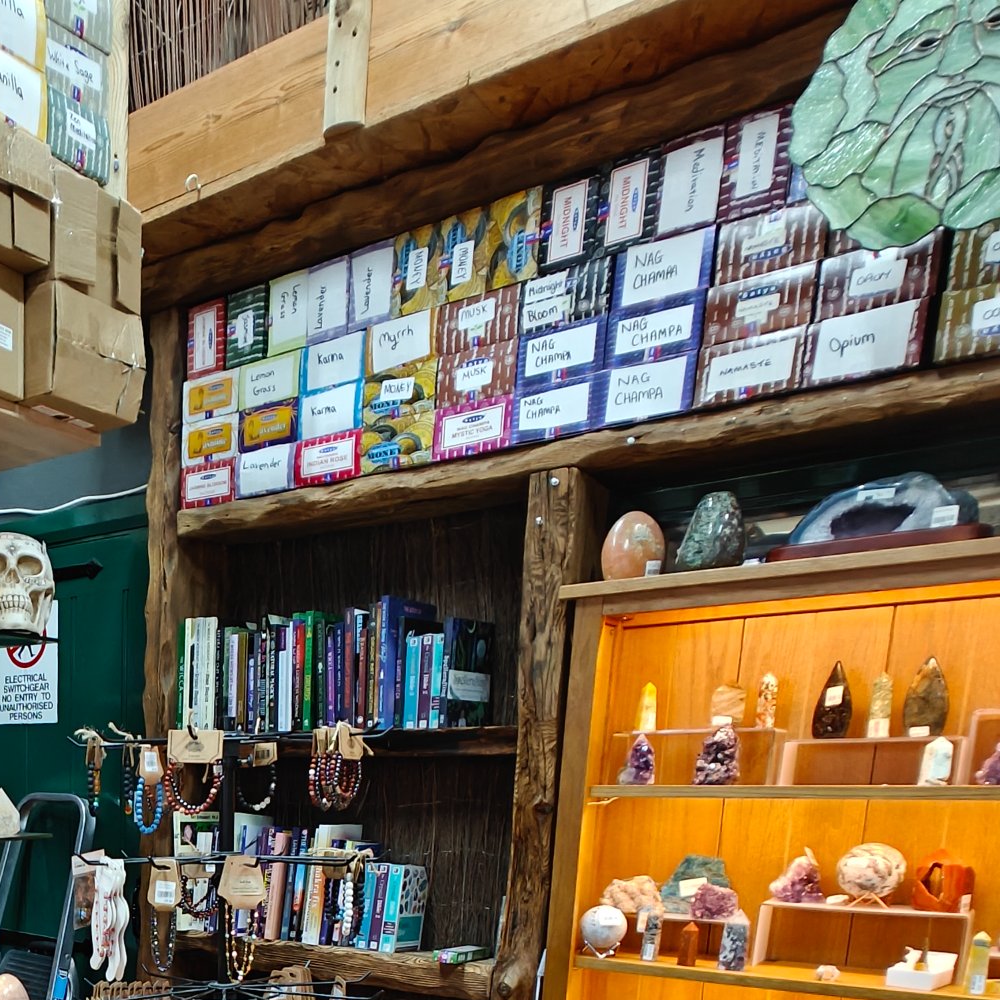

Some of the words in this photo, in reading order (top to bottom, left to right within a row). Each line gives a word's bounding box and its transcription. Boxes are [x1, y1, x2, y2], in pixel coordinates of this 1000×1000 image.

[74, 59, 94, 83] Sage
[684, 147, 706, 213] Meditation
[618, 175, 631, 230] MIDNIGHT
[559, 196, 572, 249] MIDNIGHT
[455, 246, 469, 280] MONEY
[634, 250, 664, 270] NAG
[410, 250, 424, 286] MONEY
[632, 264, 678, 289] CHAMPA
[528, 281, 564, 297] Midnight
[461, 304, 488, 321] MUSK
[621, 317, 649, 334] NAG
[378, 328, 414, 351] Myrrh
[631, 324, 683, 346] CHAMPA
[531, 338, 555, 353] NAG
[828, 331, 875, 357] Opium
[317, 352, 345, 365] Karma
[535, 351, 572, 368] CHAMPA
[462, 366, 487, 380] MUSK
[718, 358, 772, 376] NAMASTE
[250, 369, 275, 382] Lemon
[618, 372, 651, 387] NAG
[253, 384, 276, 396] Grass
[383, 382, 412, 395] MONEY
[614, 386, 664, 406] CHAMPA
[524, 397, 543, 407] NAG
[310, 405, 337, 416] Karma
[526, 405, 561, 420] CHAMPA
[451, 430, 474, 439] MYSTIC
[475, 425, 493, 435] YOGA
[242, 457, 283, 472] Lavender
[307, 457, 328, 467] INDIAN
[329, 454, 349, 464] ROSE
[5, 673, 47, 684] ELECTRICAL
[4, 683, 50, 693] SWITCHGEAR
[2, 694, 12, 703] NO
[14, 692, 38, 702] ENTRY
[41, 692, 51, 701] TO
[0, 701, 54, 712] UNAUTHORISED
[9, 711, 43, 720] PERSONS
[313, 866, 323, 894] hakra
